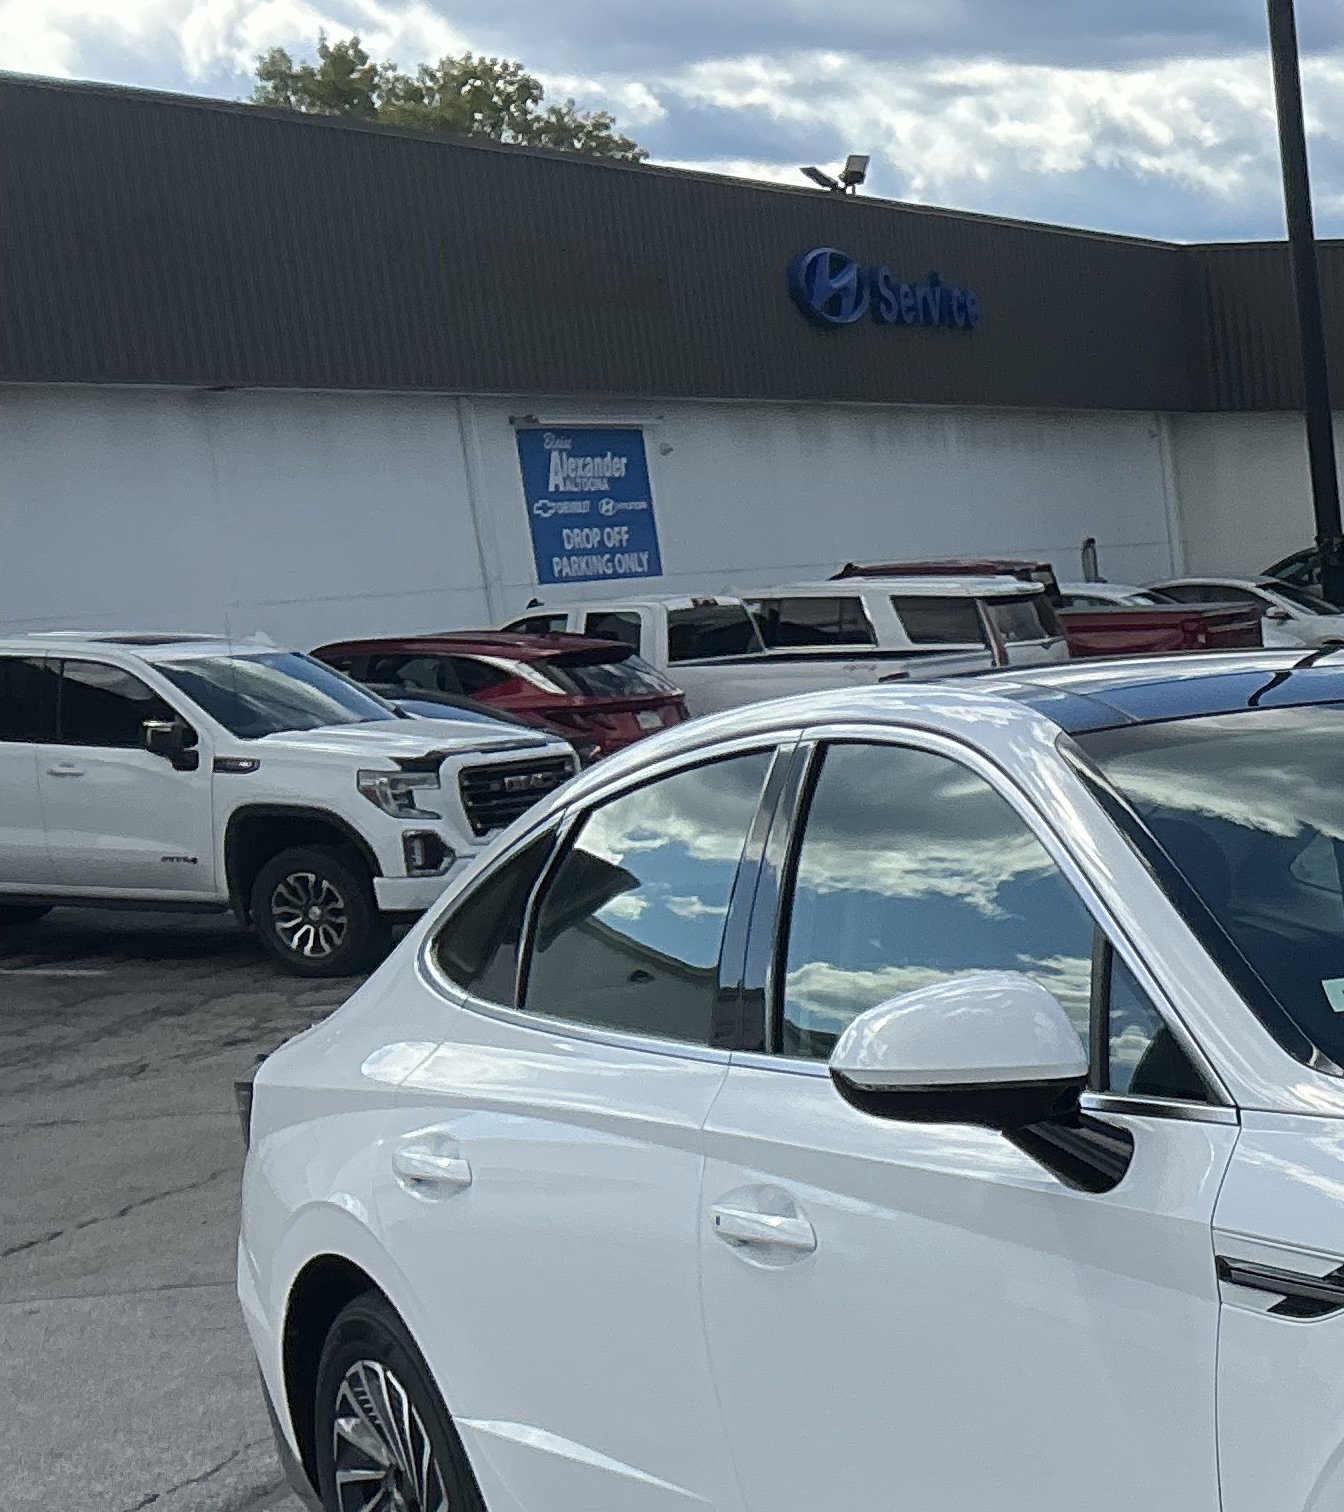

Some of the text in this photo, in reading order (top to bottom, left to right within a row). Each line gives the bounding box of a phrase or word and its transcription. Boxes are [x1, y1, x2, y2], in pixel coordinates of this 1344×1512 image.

[548, 450, 627, 492] Alexander
[562, 526, 629, 550] DROP OFF
[552, 551, 649, 577] PARKING ONLY
